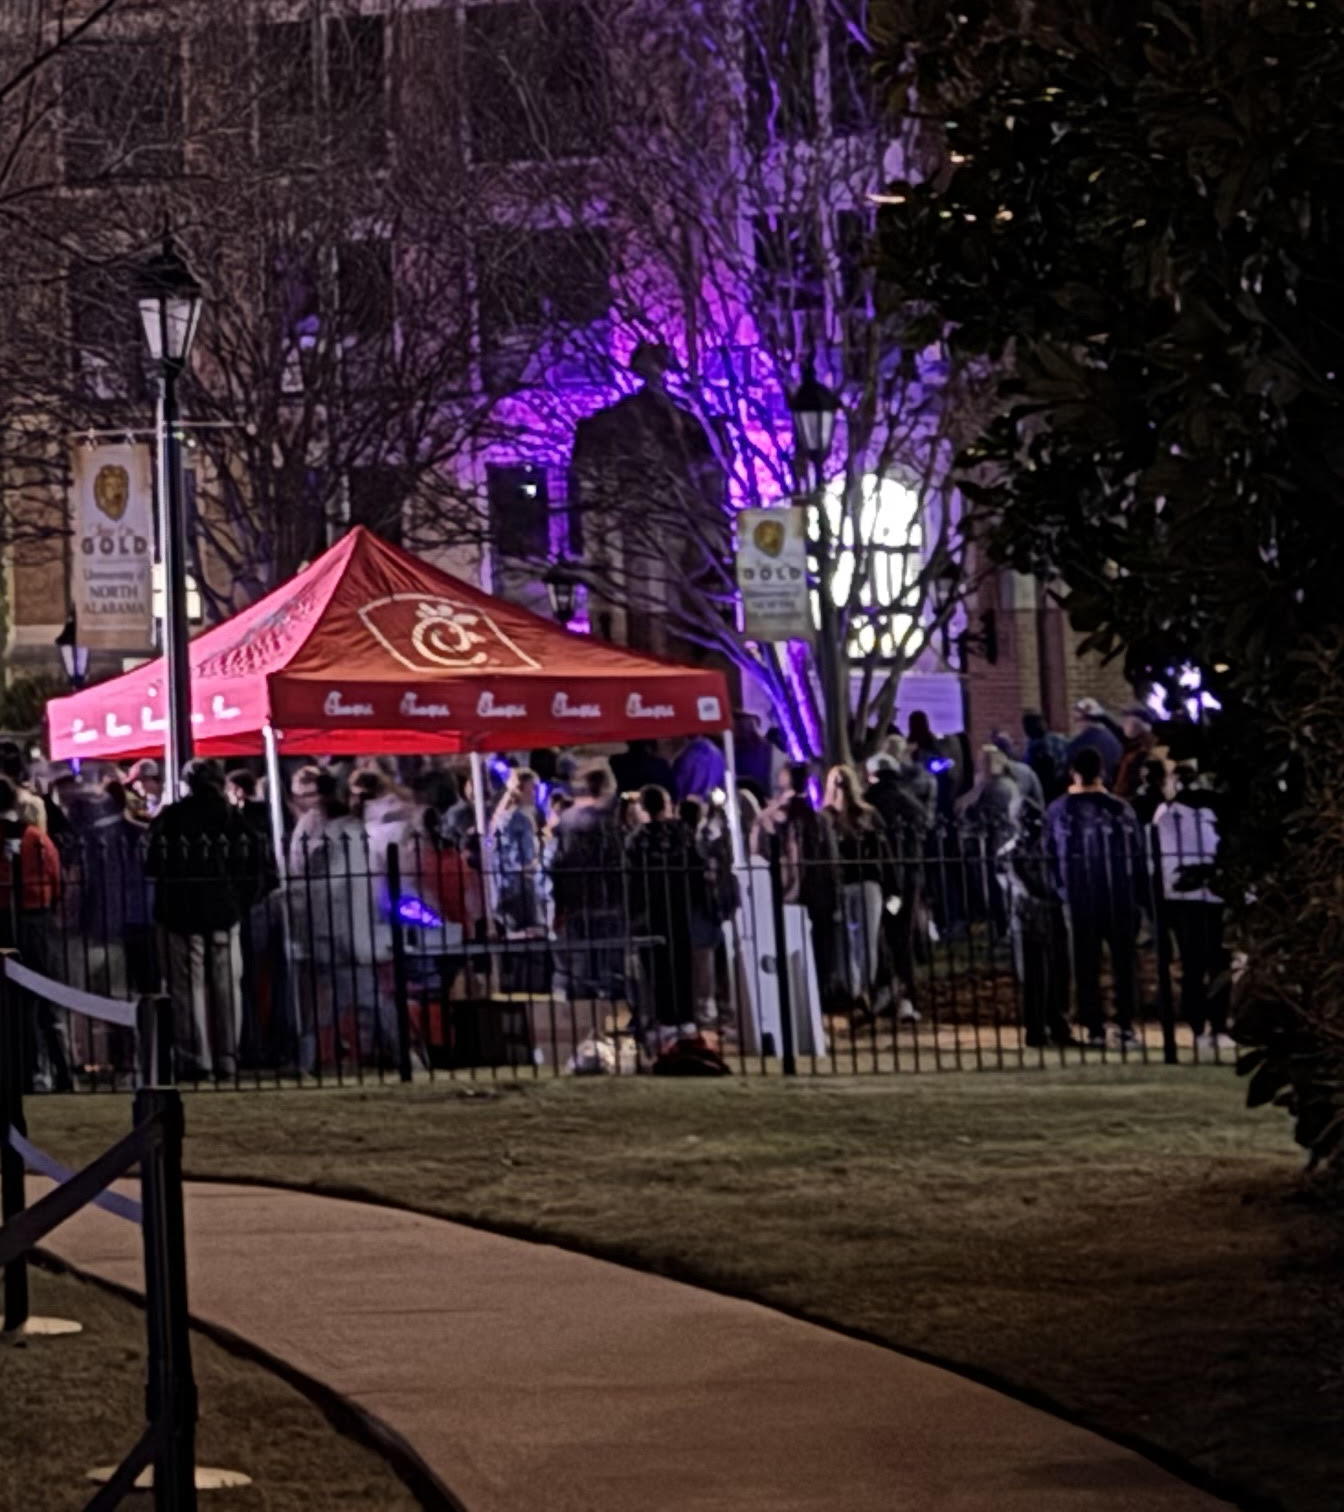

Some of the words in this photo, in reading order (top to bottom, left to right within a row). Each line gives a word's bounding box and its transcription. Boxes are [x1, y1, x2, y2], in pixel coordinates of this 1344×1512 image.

[81, 537, 148, 555] GOLD
[90, 586, 138, 598] NORTH
[83, 601, 145, 614] ALABAMA
